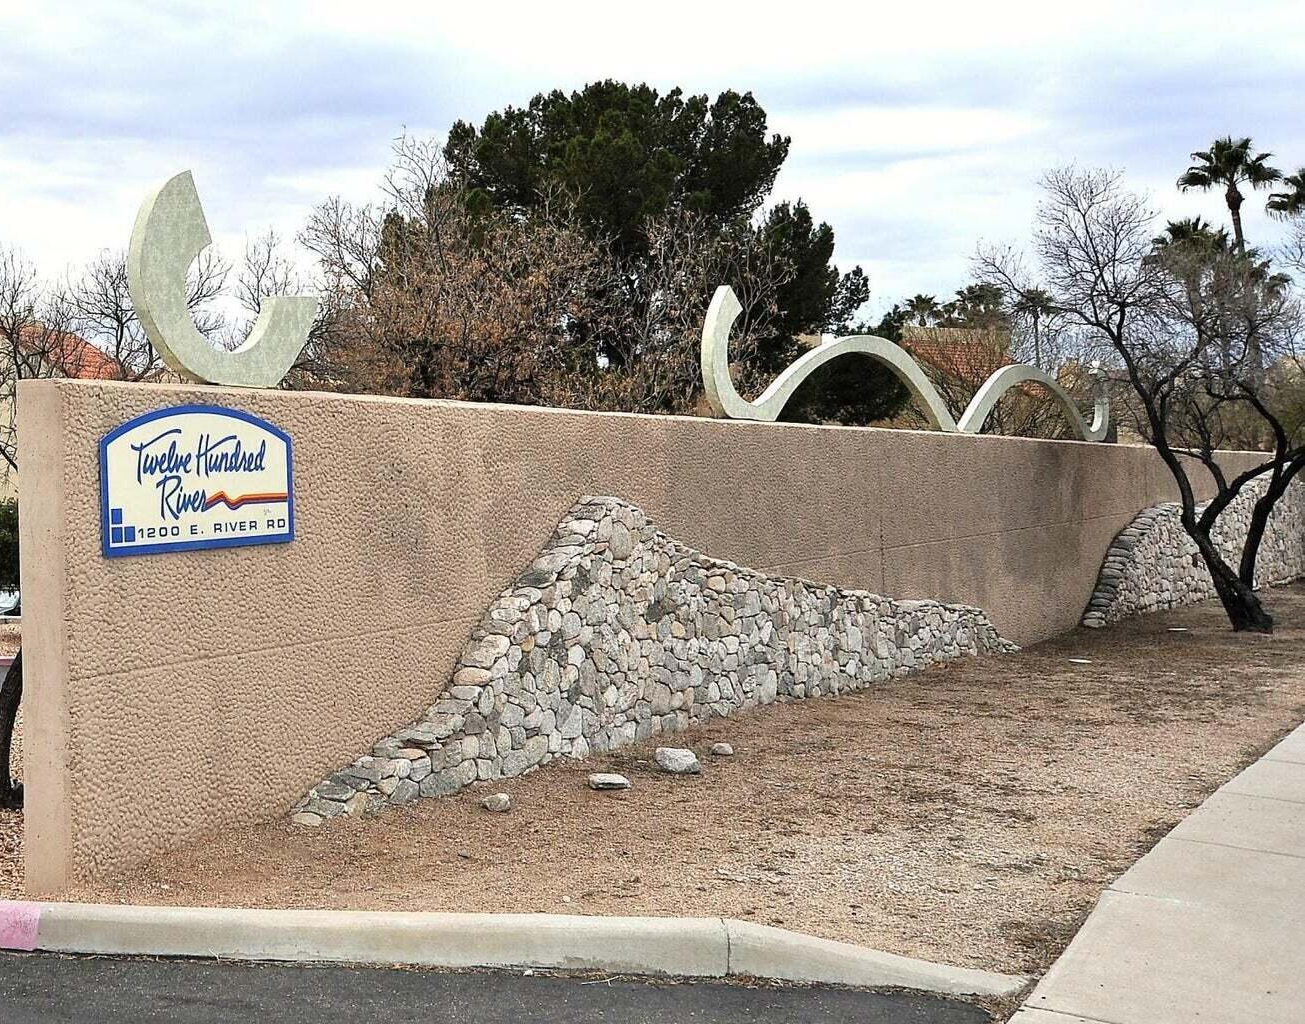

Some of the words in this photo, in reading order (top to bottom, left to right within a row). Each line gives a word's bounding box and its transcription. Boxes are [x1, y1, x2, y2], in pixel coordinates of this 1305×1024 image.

[130, 428, 192, 485] Twelve
[196, 433, 266, 478] Hundred
[156, 475, 207, 520] River
[138, 526, 180, 539] 1200
[190, 524, 204, 535] E.
[214, 520, 258, 533] RIVER
[267, 518, 286, 529] RD
